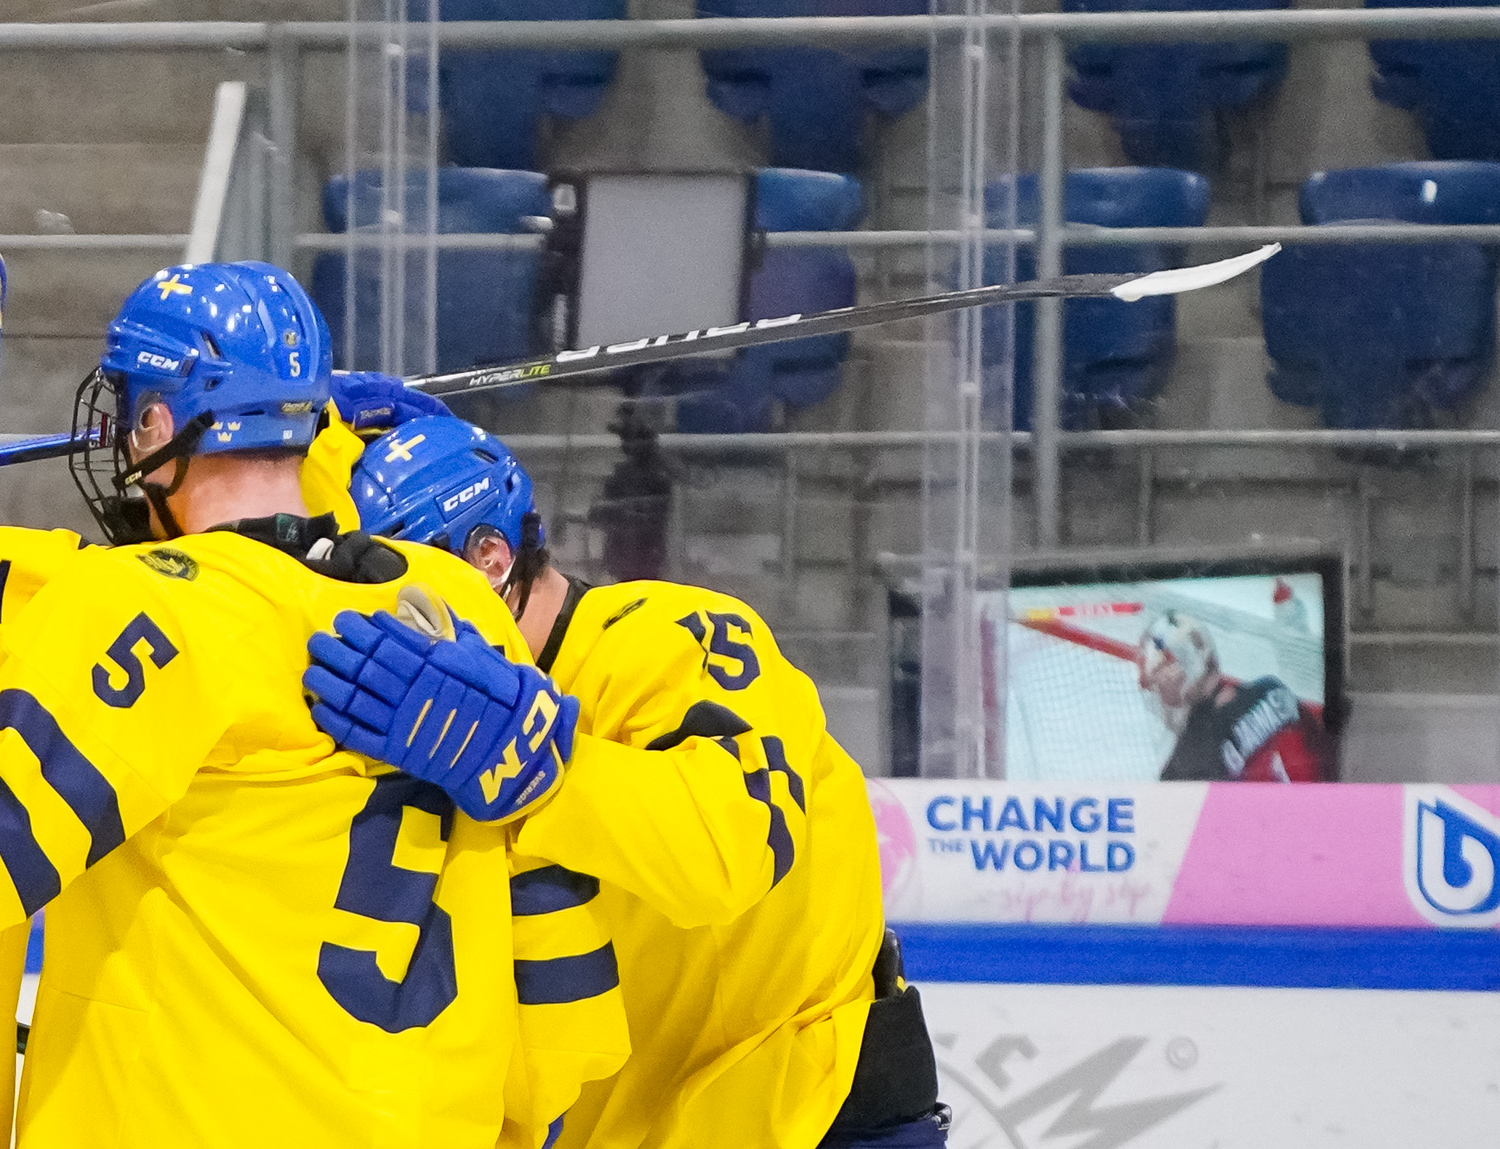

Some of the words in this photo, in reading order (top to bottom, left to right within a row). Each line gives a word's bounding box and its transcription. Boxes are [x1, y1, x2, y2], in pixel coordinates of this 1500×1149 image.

[138, 351, 179, 371] CCM
[289, 352, 301, 377] 5
[469, 364, 551, 386] HYPERLITE
[443, 478, 491, 513] CCM
[91, 610, 180, 709] 5
[926, 795, 1136, 834] CHANGE
[927, 838, 966, 854] THE
[970, 838, 1137, 875] WORLD
[316, 772, 458, 1034] 5
